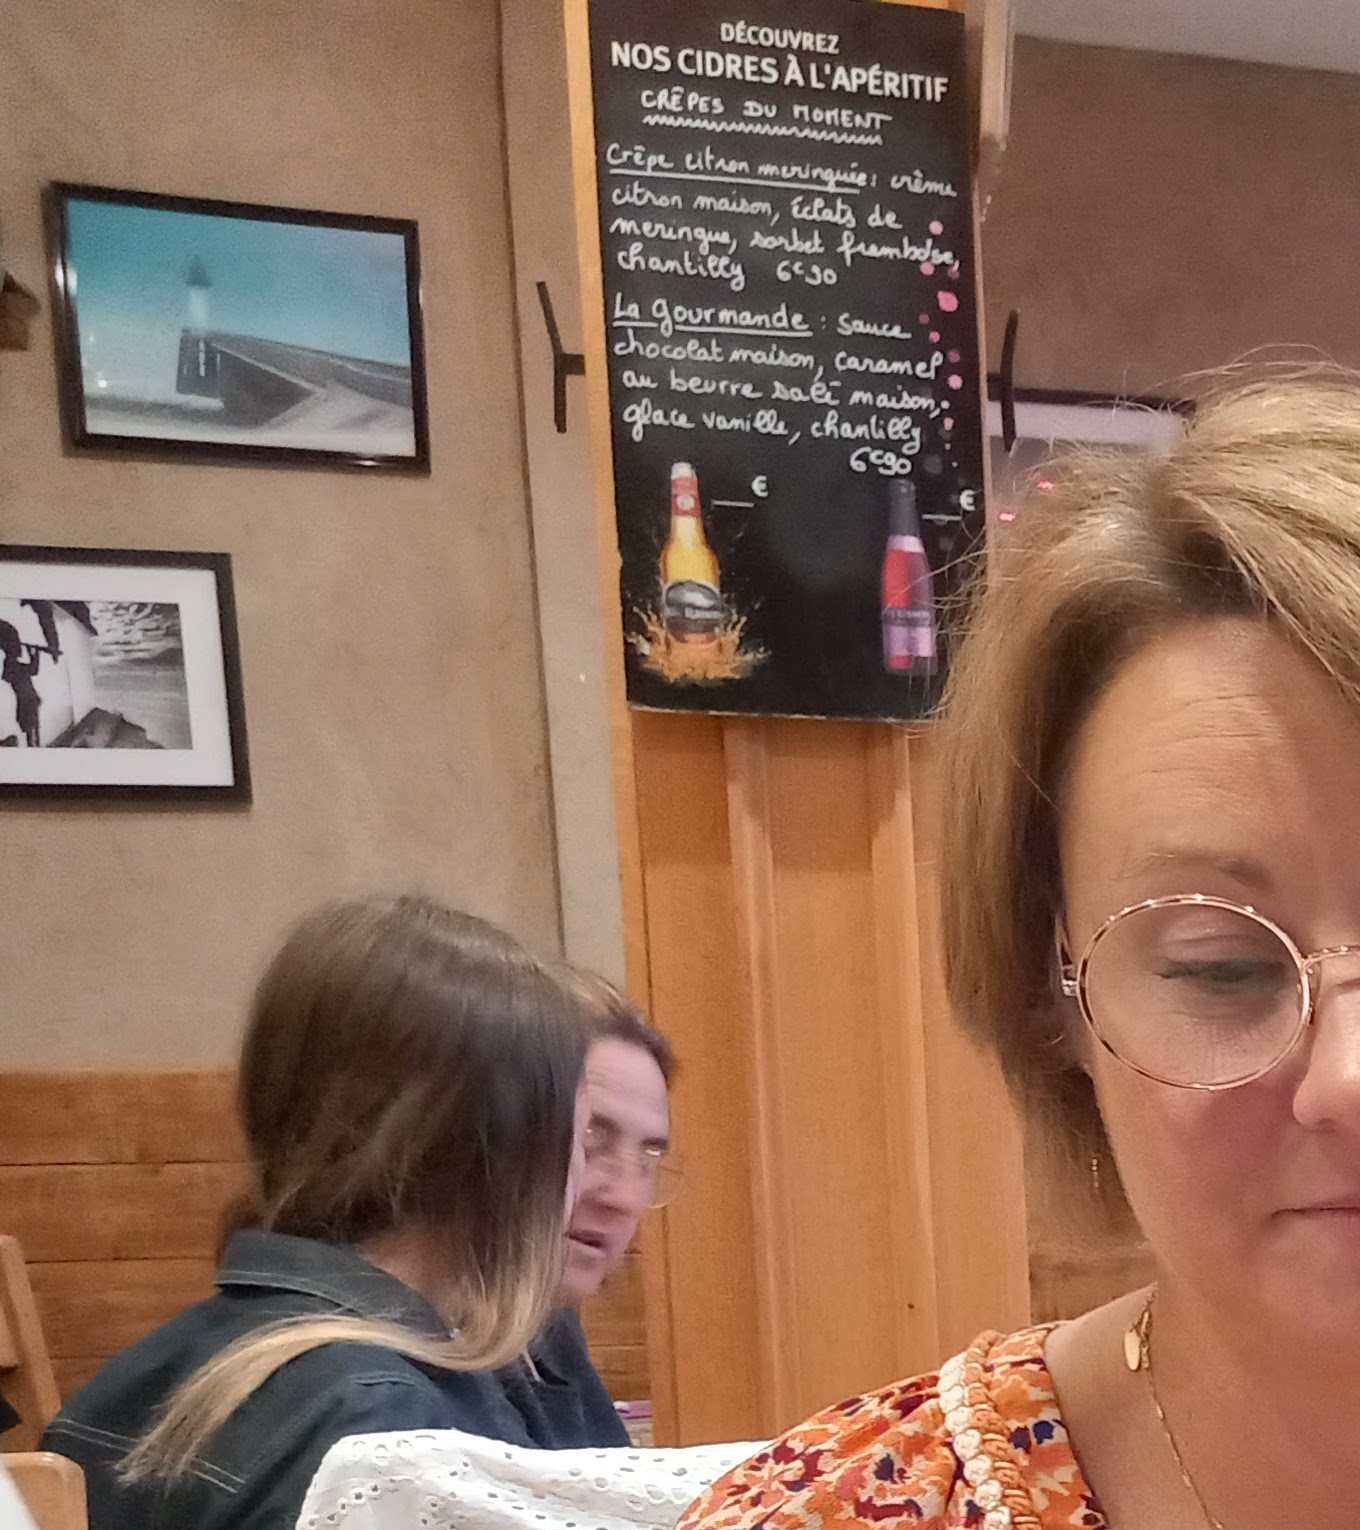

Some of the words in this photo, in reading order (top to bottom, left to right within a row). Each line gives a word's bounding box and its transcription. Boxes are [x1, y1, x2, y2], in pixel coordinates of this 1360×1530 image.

[720, 20, 839, 54] DÉCOUVREZ
[611, 41, 671, 72] NOS
[677, 48, 779, 83] CIDRES
[784, 53, 804, 87] À
[811, 63, 949, 102] L'APÉRITIF
[641, 86, 724, 114] CRÊPES
[743, 100, 777, 118] DU
[793, 103, 893, 130] MOMENT
[606, 143, 674, 173] Crêpe
[685, 145, 749, 174] citron
[891, 168, 957, 197] crème
[612, 180, 682, 209] citron
[868, 203, 903, 229] de
[750, 227, 825, 253] sorbet
[617, 242, 745, 292] chantilly
[614, 292, 641, 320] La
[614, 328, 724, 363] chocolat
[623, 370, 659, 389] au
[670, 366, 764, 399] beurre
[771, 381, 842, 406] salé
[623, 398, 695, 442] glace
[811, 409, 922, 456] chantilly
[752, 475, 769, 498] €
[960, 489, 976, 511] €
